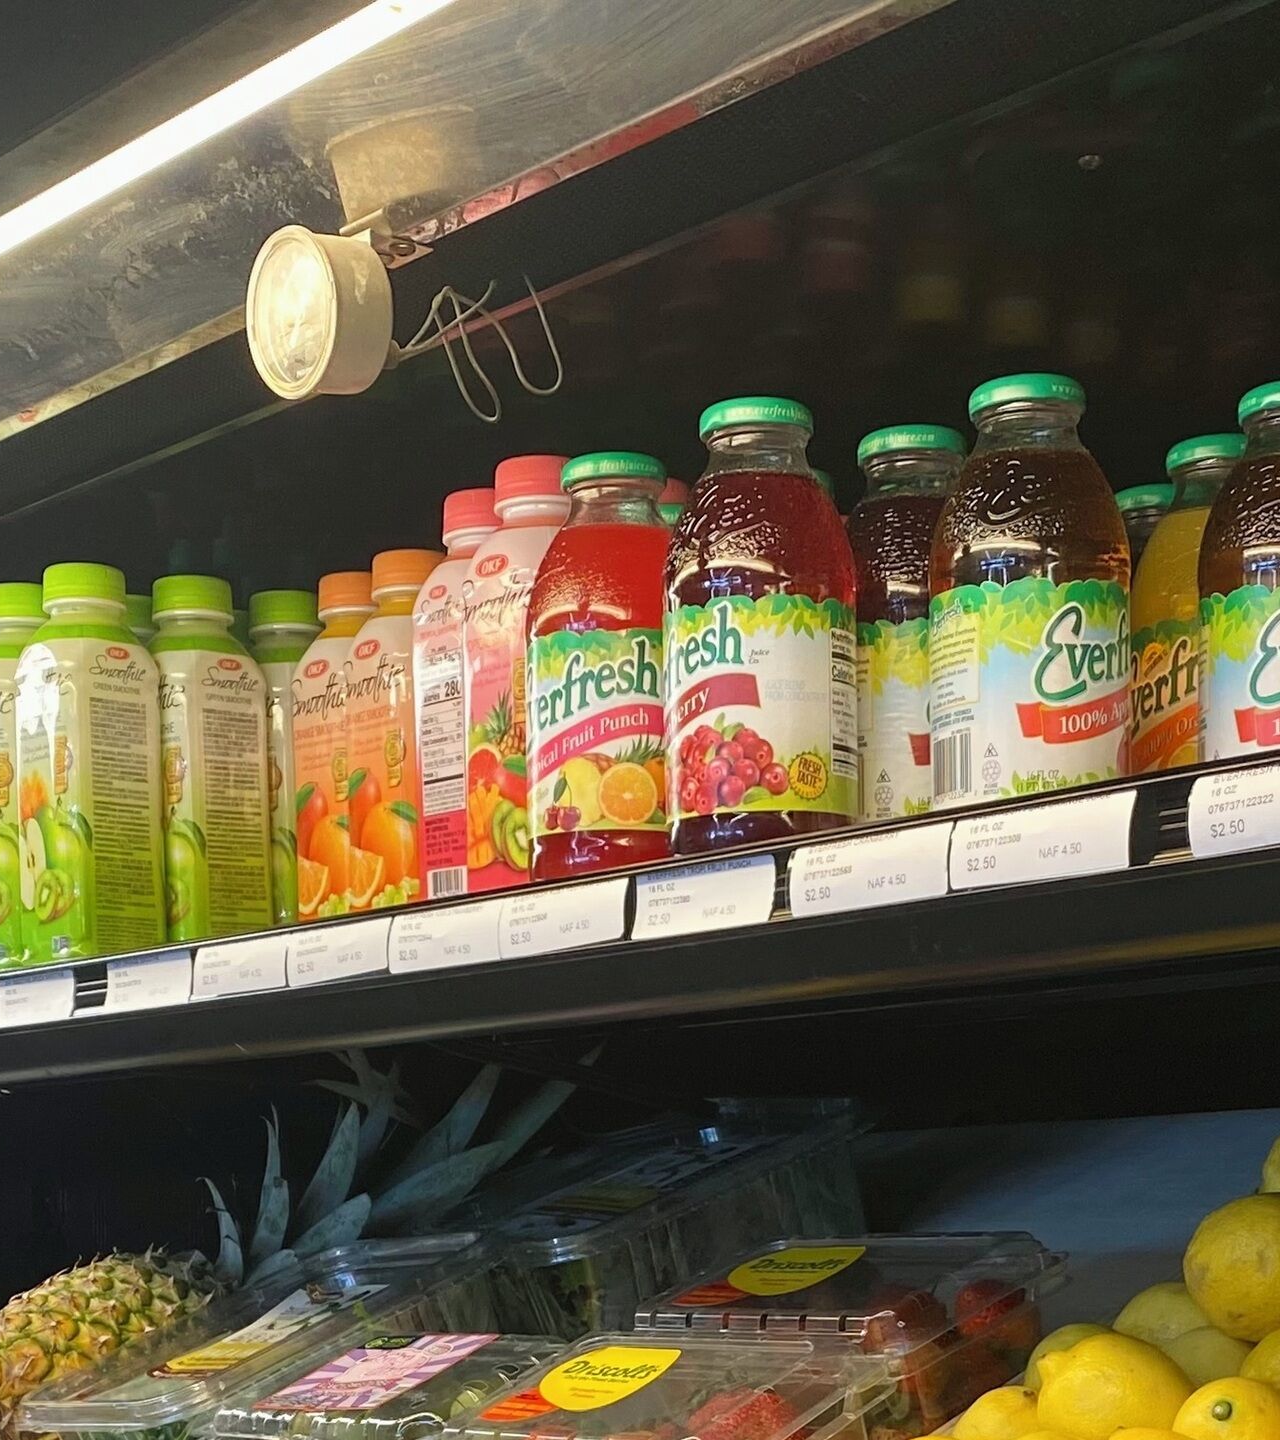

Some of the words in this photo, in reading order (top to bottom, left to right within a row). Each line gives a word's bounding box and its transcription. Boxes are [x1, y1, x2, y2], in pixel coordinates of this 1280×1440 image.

[481, 556, 503, 576] OKF
[358, 642, 377, 658] OKF
[89, 655, 146, 684] Smoothie
[562, 724, 595, 755] Fruit
[599, 707, 649, 736] Punch
[1059, 710, 1109, 735] 100%
[797, 756, 822, 778] FRESH
[795, 770, 822, 791] TASTE
[1224, 784, 1238, 795] OZ
[966, 856, 997, 872] $2.50
[1038, 845, 1059, 859] NAF
[804, 886, 831, 902] $2.50
[868, 877, 886, 889] NAF
[702, 907, 719, 918] NAF
[560, 923, 573, 934] NAF
[563, 1361, 657, 1379] Driscoll's
